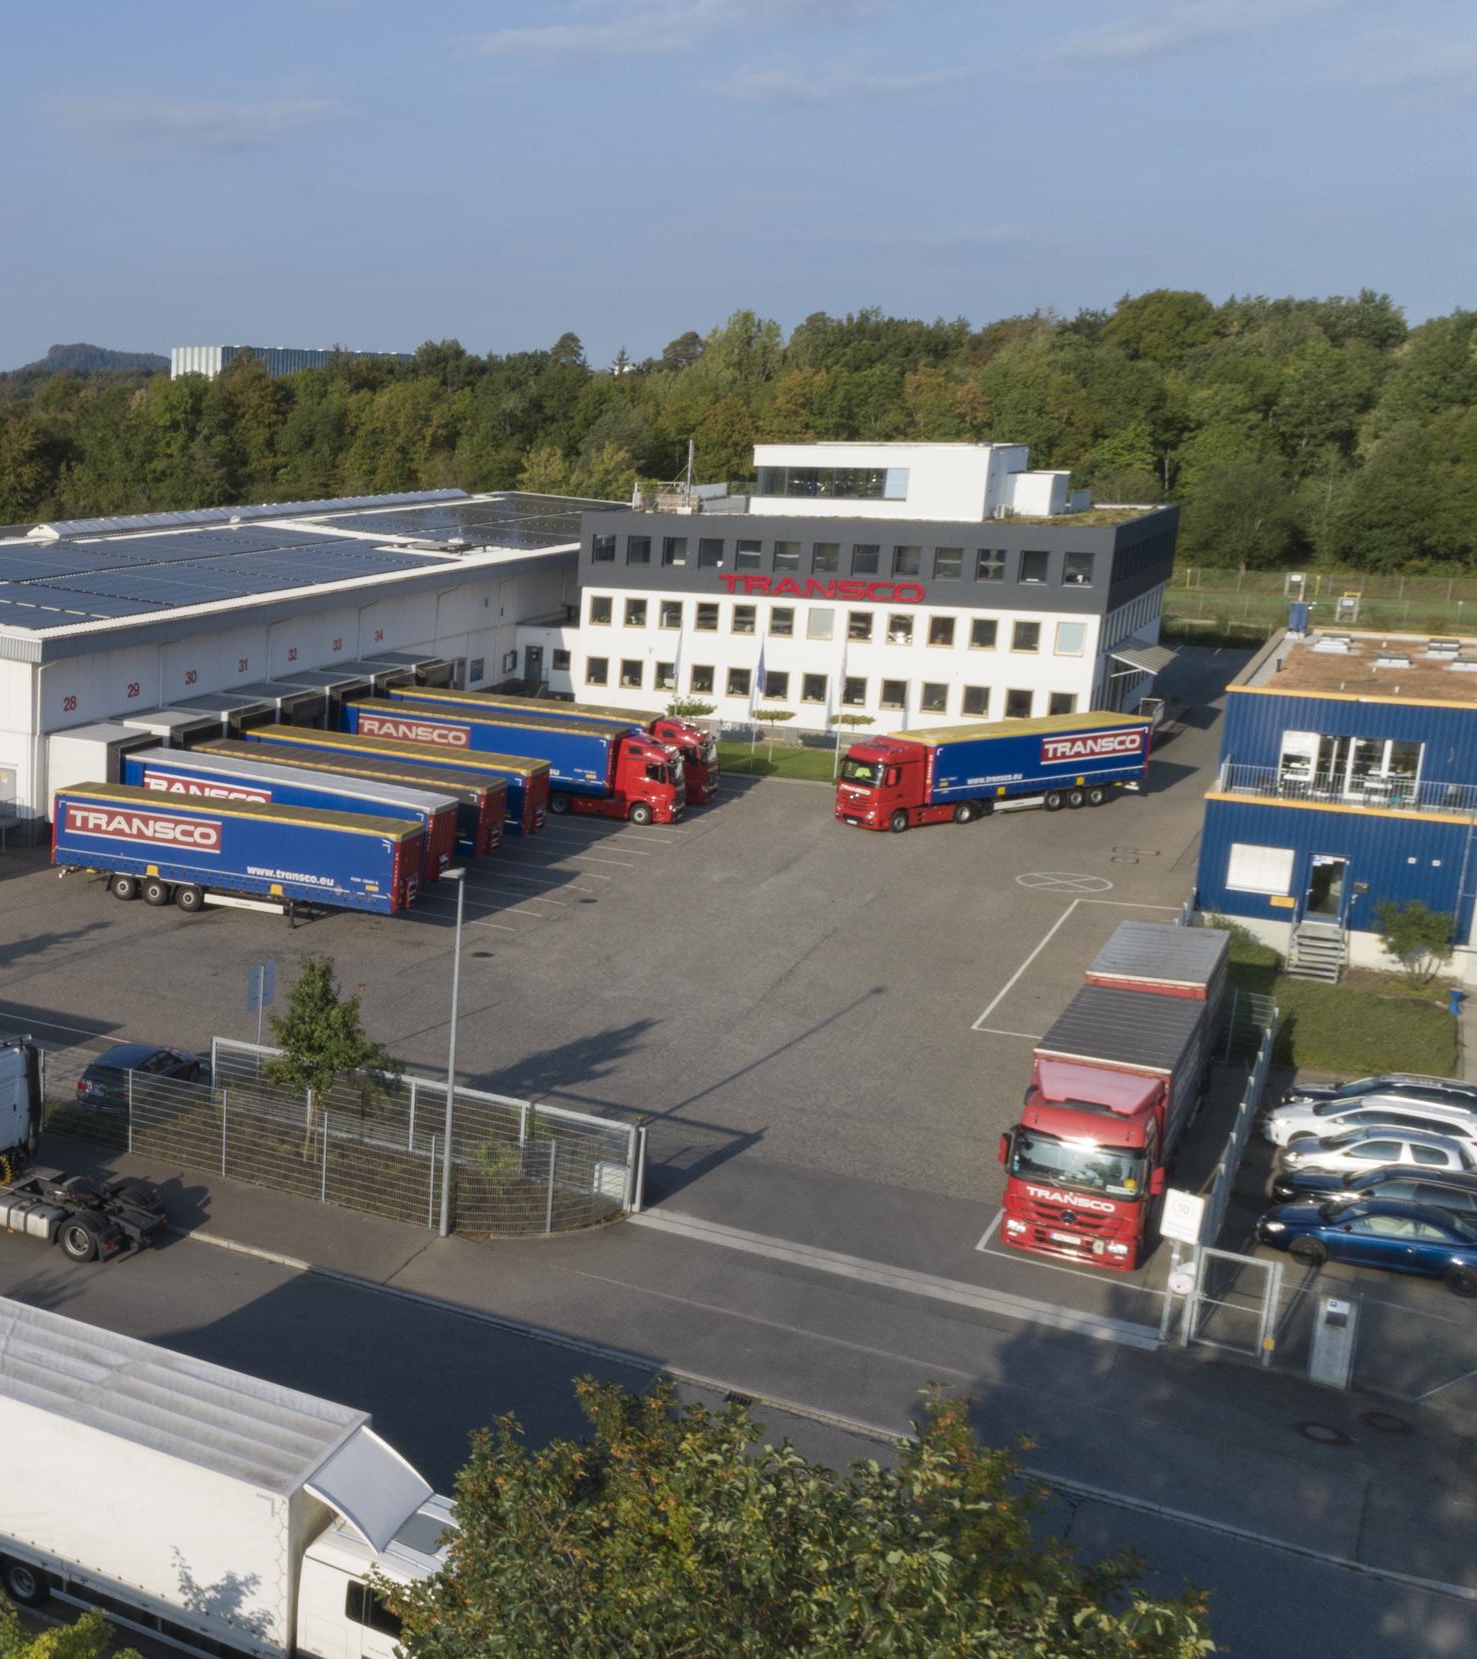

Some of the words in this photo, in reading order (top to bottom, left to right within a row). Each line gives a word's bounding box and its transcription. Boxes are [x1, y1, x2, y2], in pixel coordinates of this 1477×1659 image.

[719, 574, 925, 603] TRANSCO
[375, 629, 383, 642] 34
[332, 638, 342, 651] 33
[288, 648, 297, 661] 32
[238, 659, 248, 672] 31
[185, 670, 198, 684] 30
[127, 682, 140, 698] 29
[63, 695, 77, 712] 28
[359, 719, 467, 745] RANSCO
[1044, 734, 1141, 758] TRANSCO
[840, 784, 871, 796] TRANSCO
[69, 809, 217, 845] TRANSCO
[246, 865, 334, 886] www.transco.eu
[1026, 1186, 1115, 1213] TRANSCO
[1178, 1203, 1189, 1215] 10
